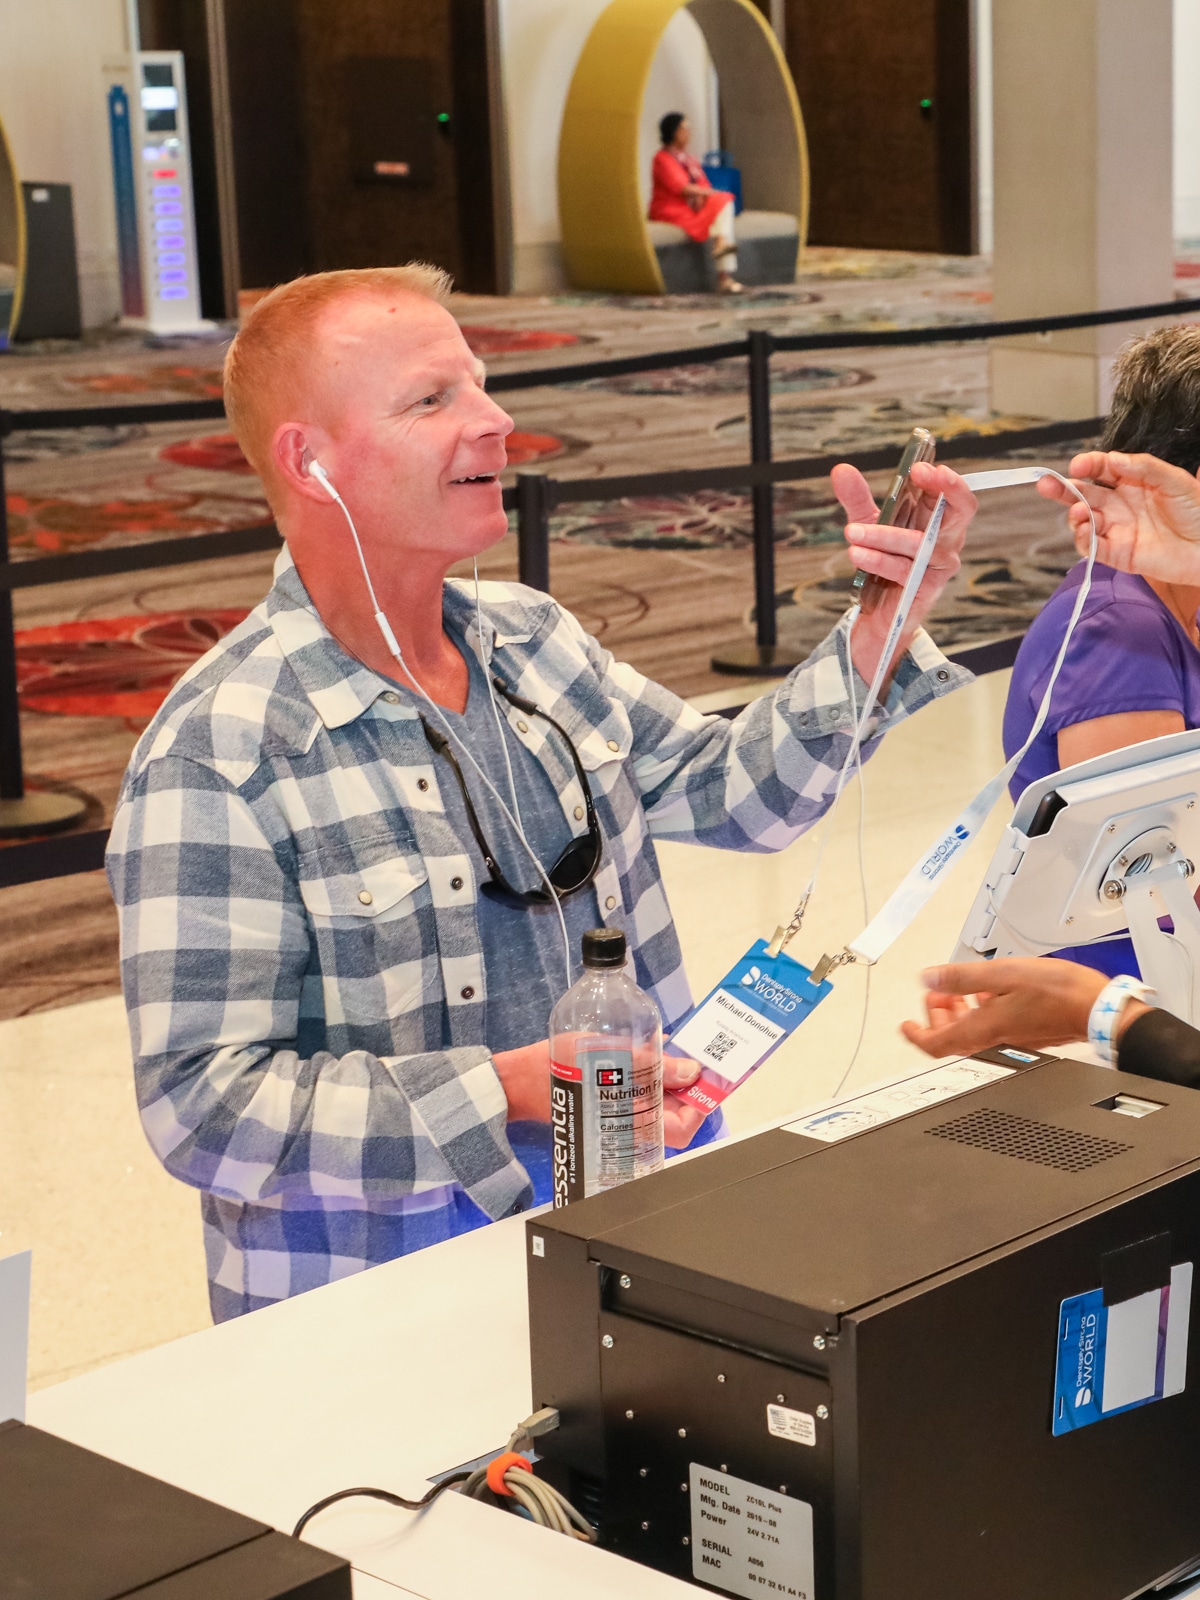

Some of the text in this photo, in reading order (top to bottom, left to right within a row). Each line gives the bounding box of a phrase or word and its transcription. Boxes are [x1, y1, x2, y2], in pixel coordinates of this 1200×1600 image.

[921, 835, 957, 875] WORLD
[753, 979, 797, 1013] WORLD
[760, 973, 786, 993] Dentsply
[784, 987, 803, 1004] Sirona
[715, 995, 748, 1019] Michael
[744, 1014, 779, 1040] Donohue
[600, 1085, 652, 1101] Nutrition
[687, 1085, 718, 1109] Sirona
[567, 1114, 576, 1144] alkaline
[600, 1123, 634, 1131] Calories
[1076, 1316, 1087, 1387] Dentsply Sirona
[1083, 1313, 1096, 1385] WORLD
[700, 1478, 730, 1496] MODEL
[768, 1502, 782, 1514] Plus
[700, 1494, 719, 1508] Mfg.
[722, 1501, 741, 1515] Date
[701, 1509, 727, 1526] Power
[747, 1527, 760, 1537] 24V
[701, 1538, 732, 1557] SERIAL
[702, 1554, 721, 1569] MAC
